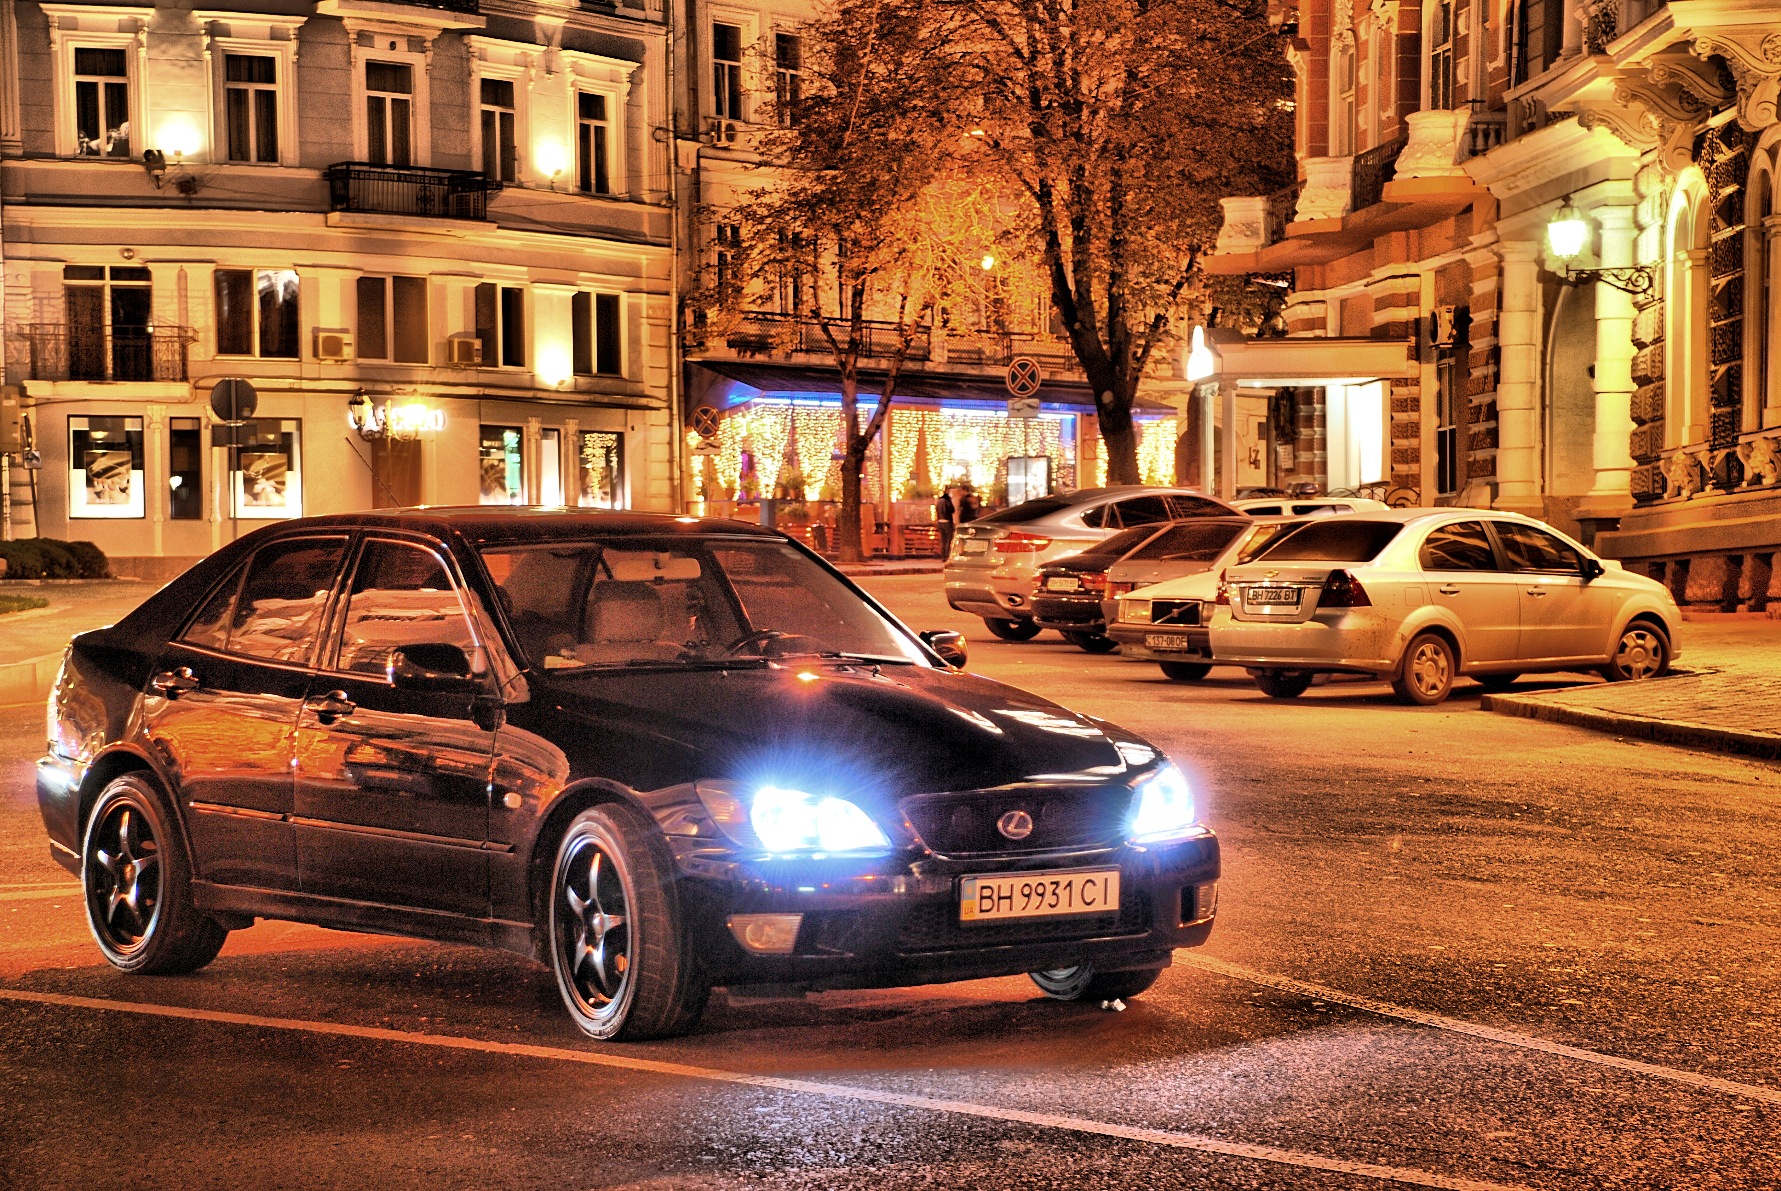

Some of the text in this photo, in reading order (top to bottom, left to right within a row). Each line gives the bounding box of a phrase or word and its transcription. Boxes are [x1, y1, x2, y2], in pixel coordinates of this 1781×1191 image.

[1252, 590, 1297, 601] BH 7226 BT
[979, 877, 1109, 914] BH 9931 CI
[964, 906, 974, 915] UA
